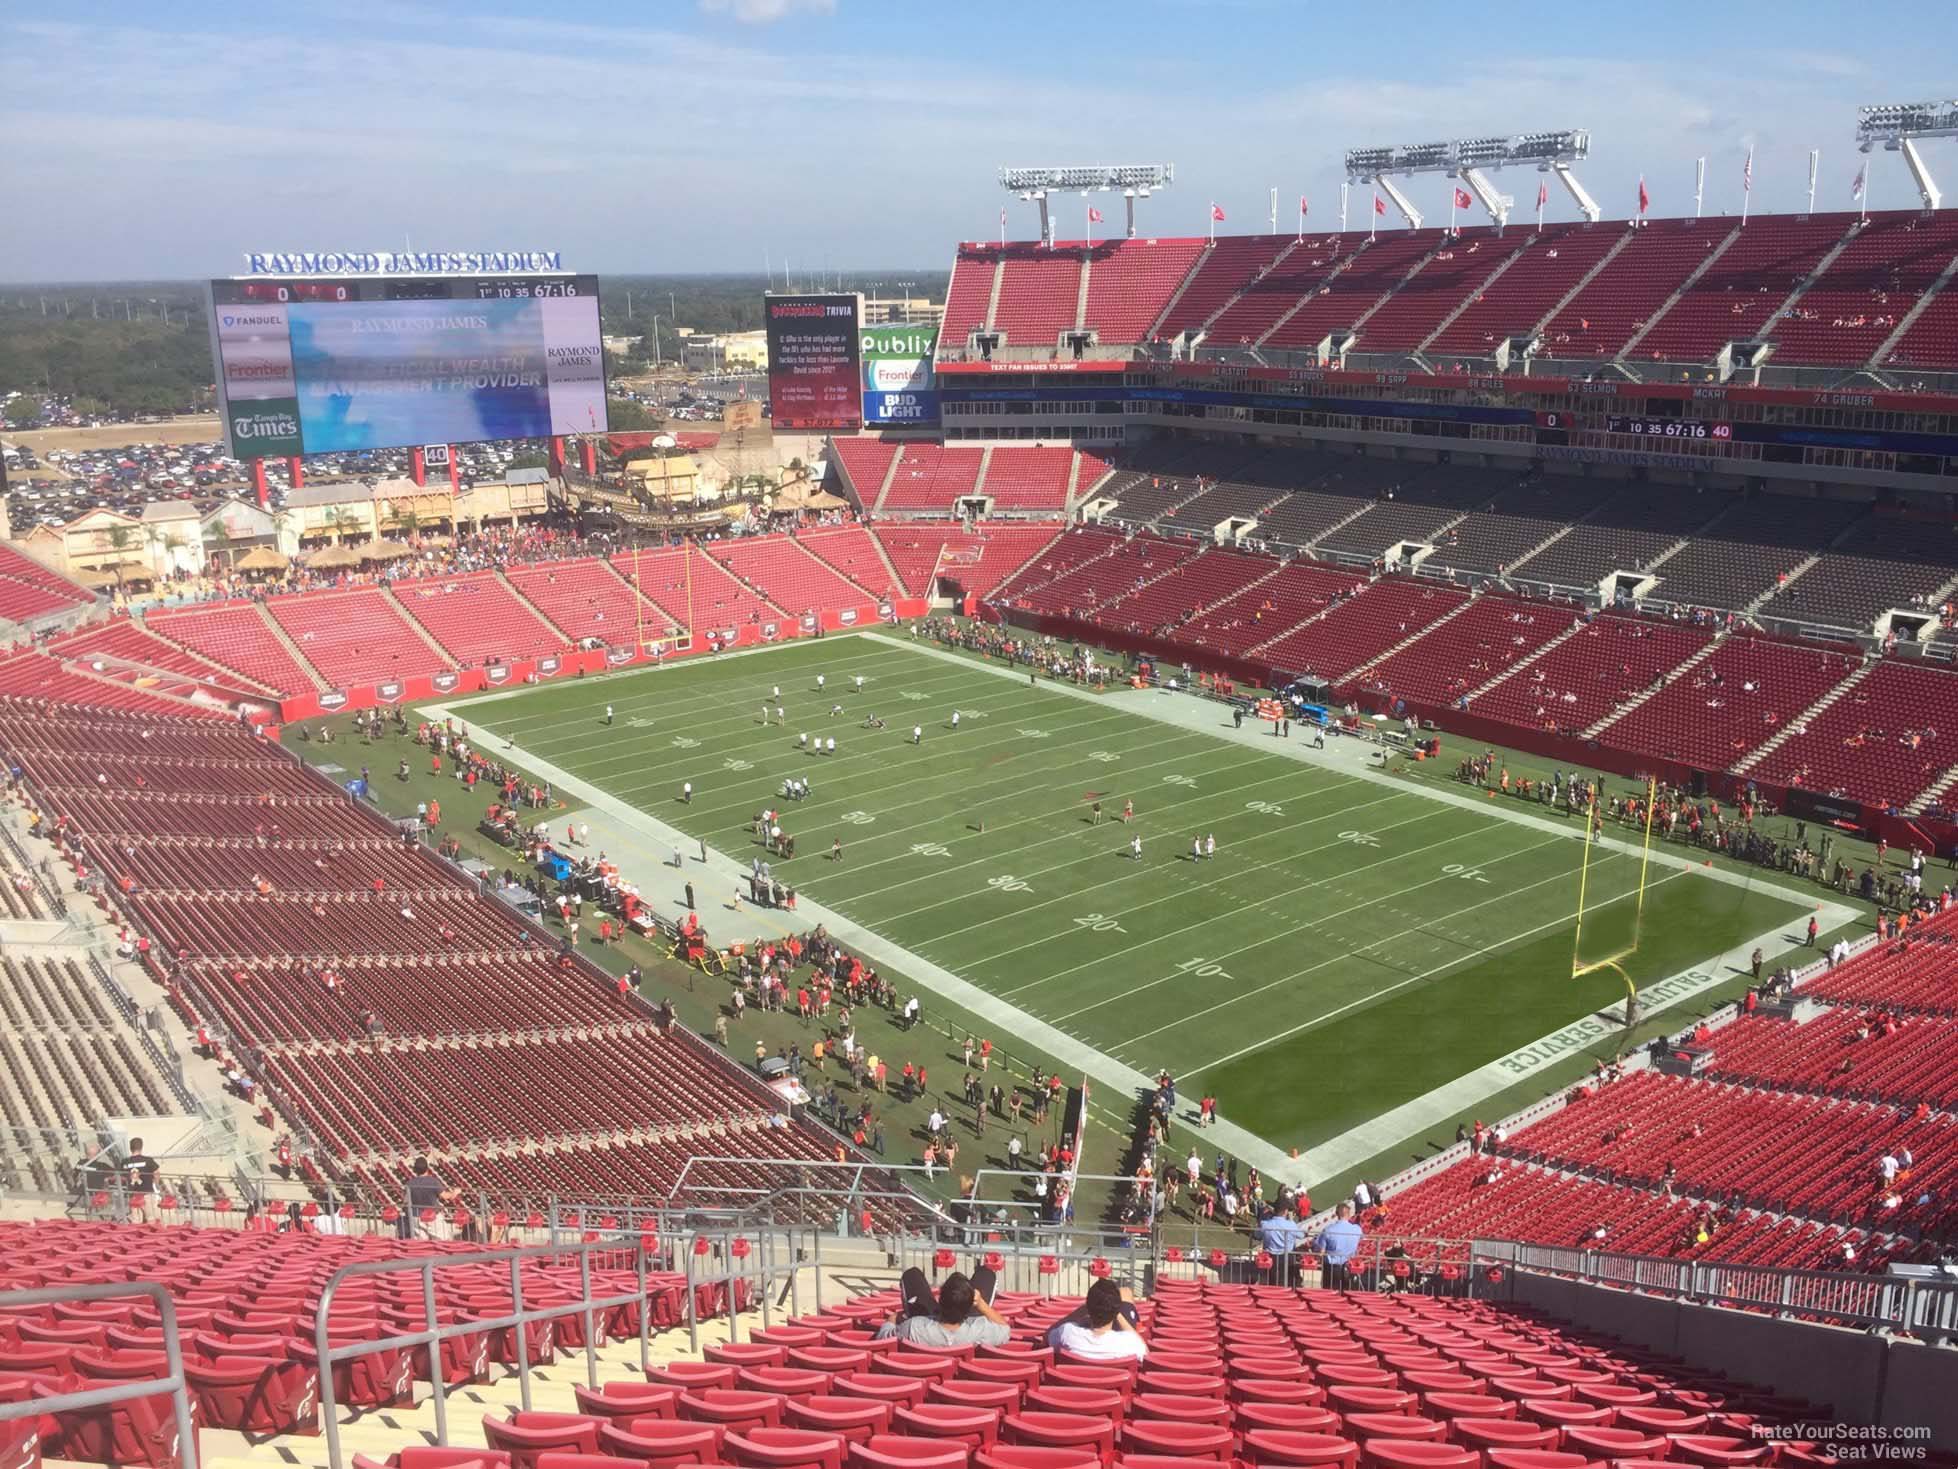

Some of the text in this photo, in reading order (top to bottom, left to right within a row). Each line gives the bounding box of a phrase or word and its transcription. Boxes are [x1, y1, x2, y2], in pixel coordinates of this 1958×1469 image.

[250, 252, 561, 273] RAYMOND JAMES STADIUM
[278, 287, 288, 301] 0
[336, 286, 346, 300] 0
[498, 288, 510, 298] 10
[515, 288, 529, 297] 35
[535, 284, 576, 297] 67:16
[826, 306, 852, 317] TRIVIA
[236, 316, 282, 325] FANDUEL
[438, 316, 487, 329] JAMES
[861, 335, 932, 355] Publix
[548, 346, 600, 358] RAYMOND
[229, 360, 289, 377] Frontier
[452, 356, 526, 373] WEALTH
[557, 357, 591, 367] JAMES
[450, 372, 541, 390] PROVIDER
[879, 368, 924, 381] Frontier
[1388, 375, 1407, 384] SAPP
[1567, 383, 1617, 394] 63 SELMON
[1693, 389, 1727, 400] MCKAY
[884, 394, 917, 406] BUD
[1813, 394, 1874, 406] 74 GRUBER
[879, 406, 923, 418] LIGHT
[1548, 414, 1556, 426] 0
[234, 417, 297, 439] Times
[1630, 423, 1642, 433] 10
[1648, 424, 1662, 434] 35
[1665, 424, 1706, 438] 67:16
[1713, 425, 1729, 437] 40
[428, 447, 446, 461] 40
[841, 811, 876, 825] 50
[910, 842, 947, 857] 40
[1441, 864, 1482, 880] 10
[988, 875, 1028, 891] 30
[1073, 913, 1117, 932] 20
[1175, 957, 1223, 977] 10
[1638, 970, 1713, 1010] SALUTE
[1500, 1020, 1604, 1074] SERVICE
